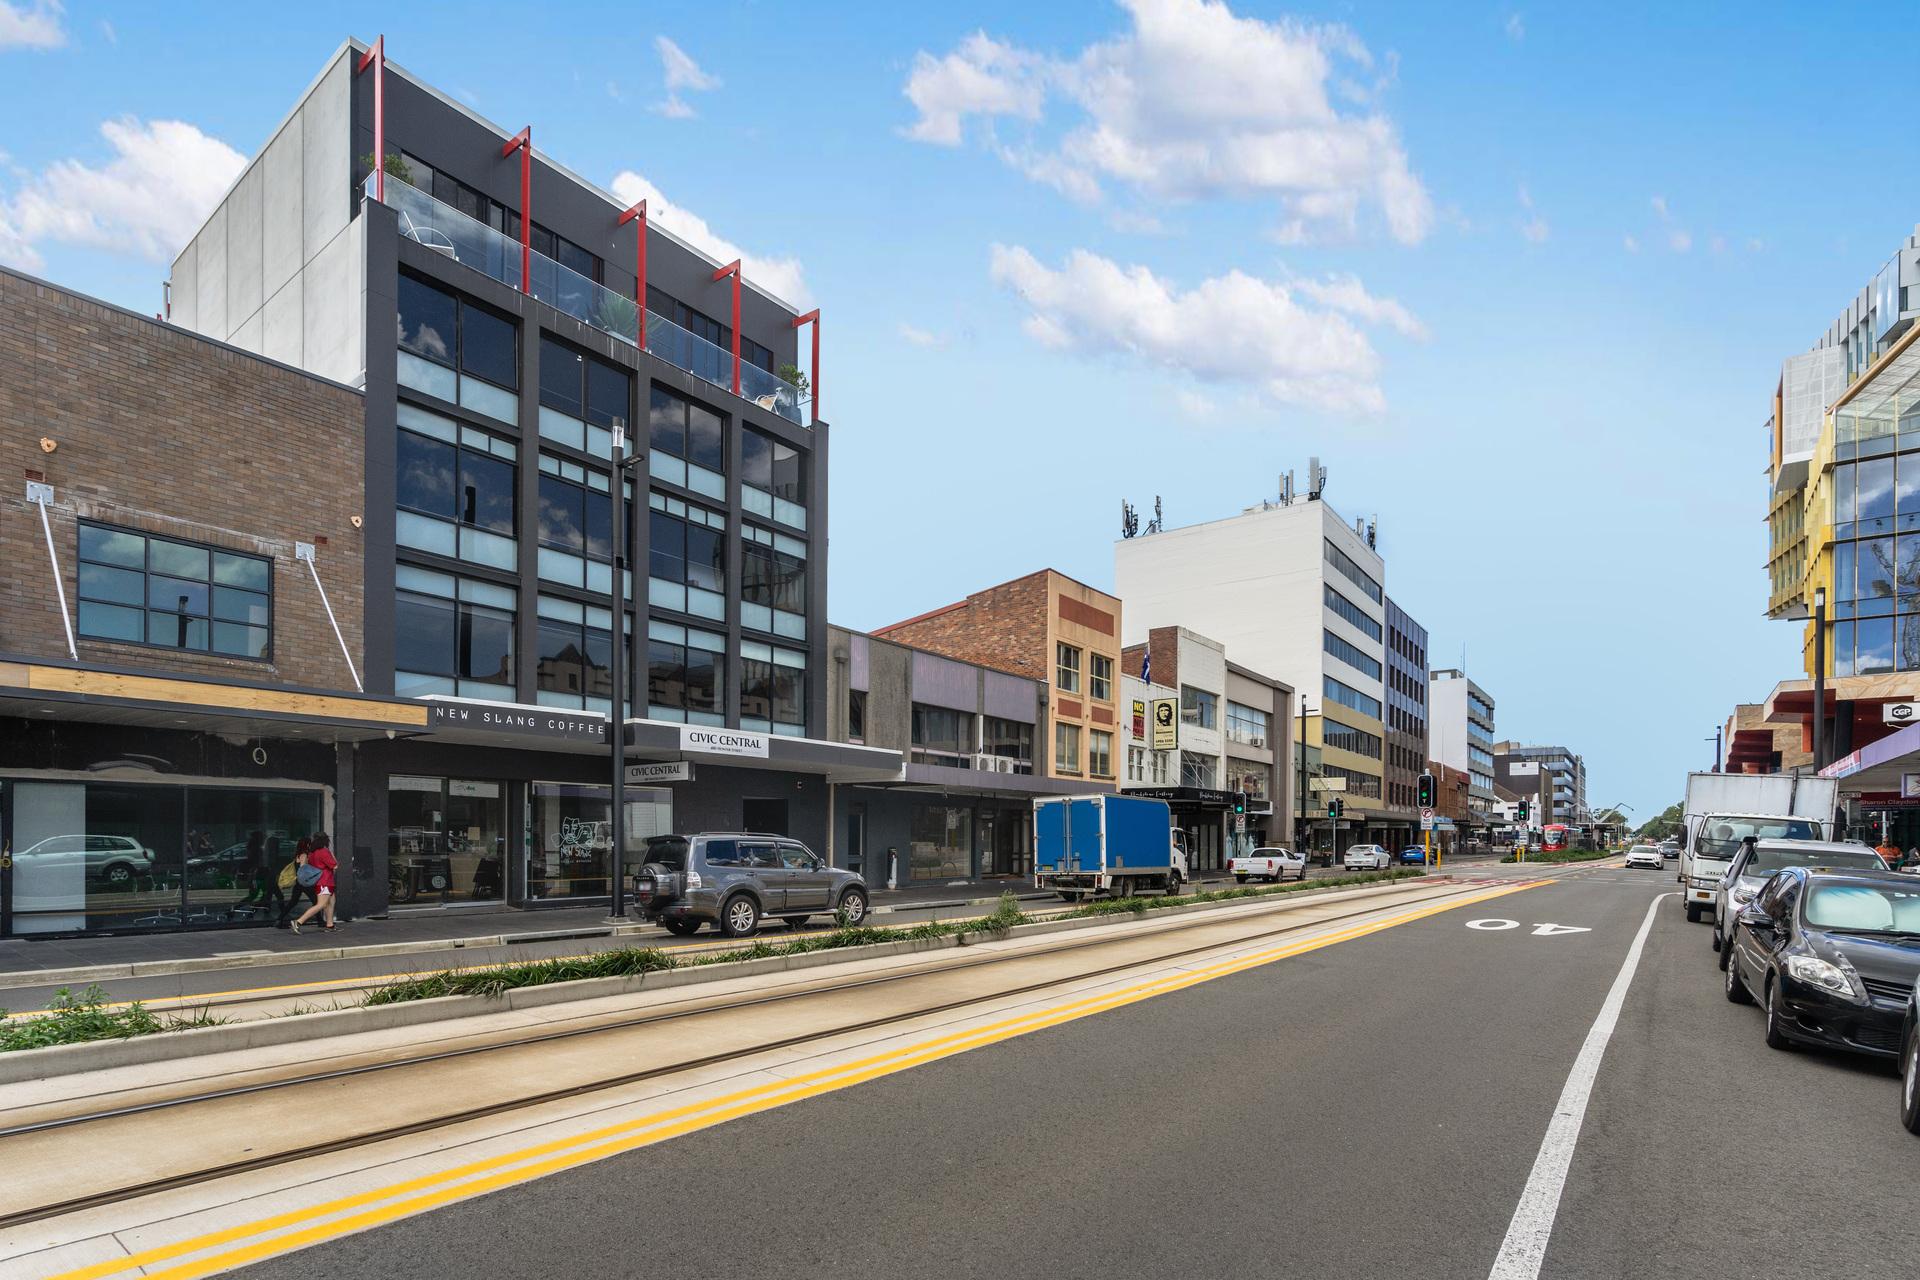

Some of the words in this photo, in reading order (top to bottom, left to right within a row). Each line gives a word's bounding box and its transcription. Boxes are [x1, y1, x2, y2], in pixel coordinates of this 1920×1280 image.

[436, 708, 469, 719] NEW
[483, 713, 535, 727] SLANG
[548, 720, 604, 734] COFFEE
[689, 732, 719, 745] CIVIC
[719, 735, 762, 749] CENTRAL
[631, 766, 650, 777] CIVIC
[650, 764, 681, 775] CENTRAL
[1887, 799, 1919, 807] Claydon
